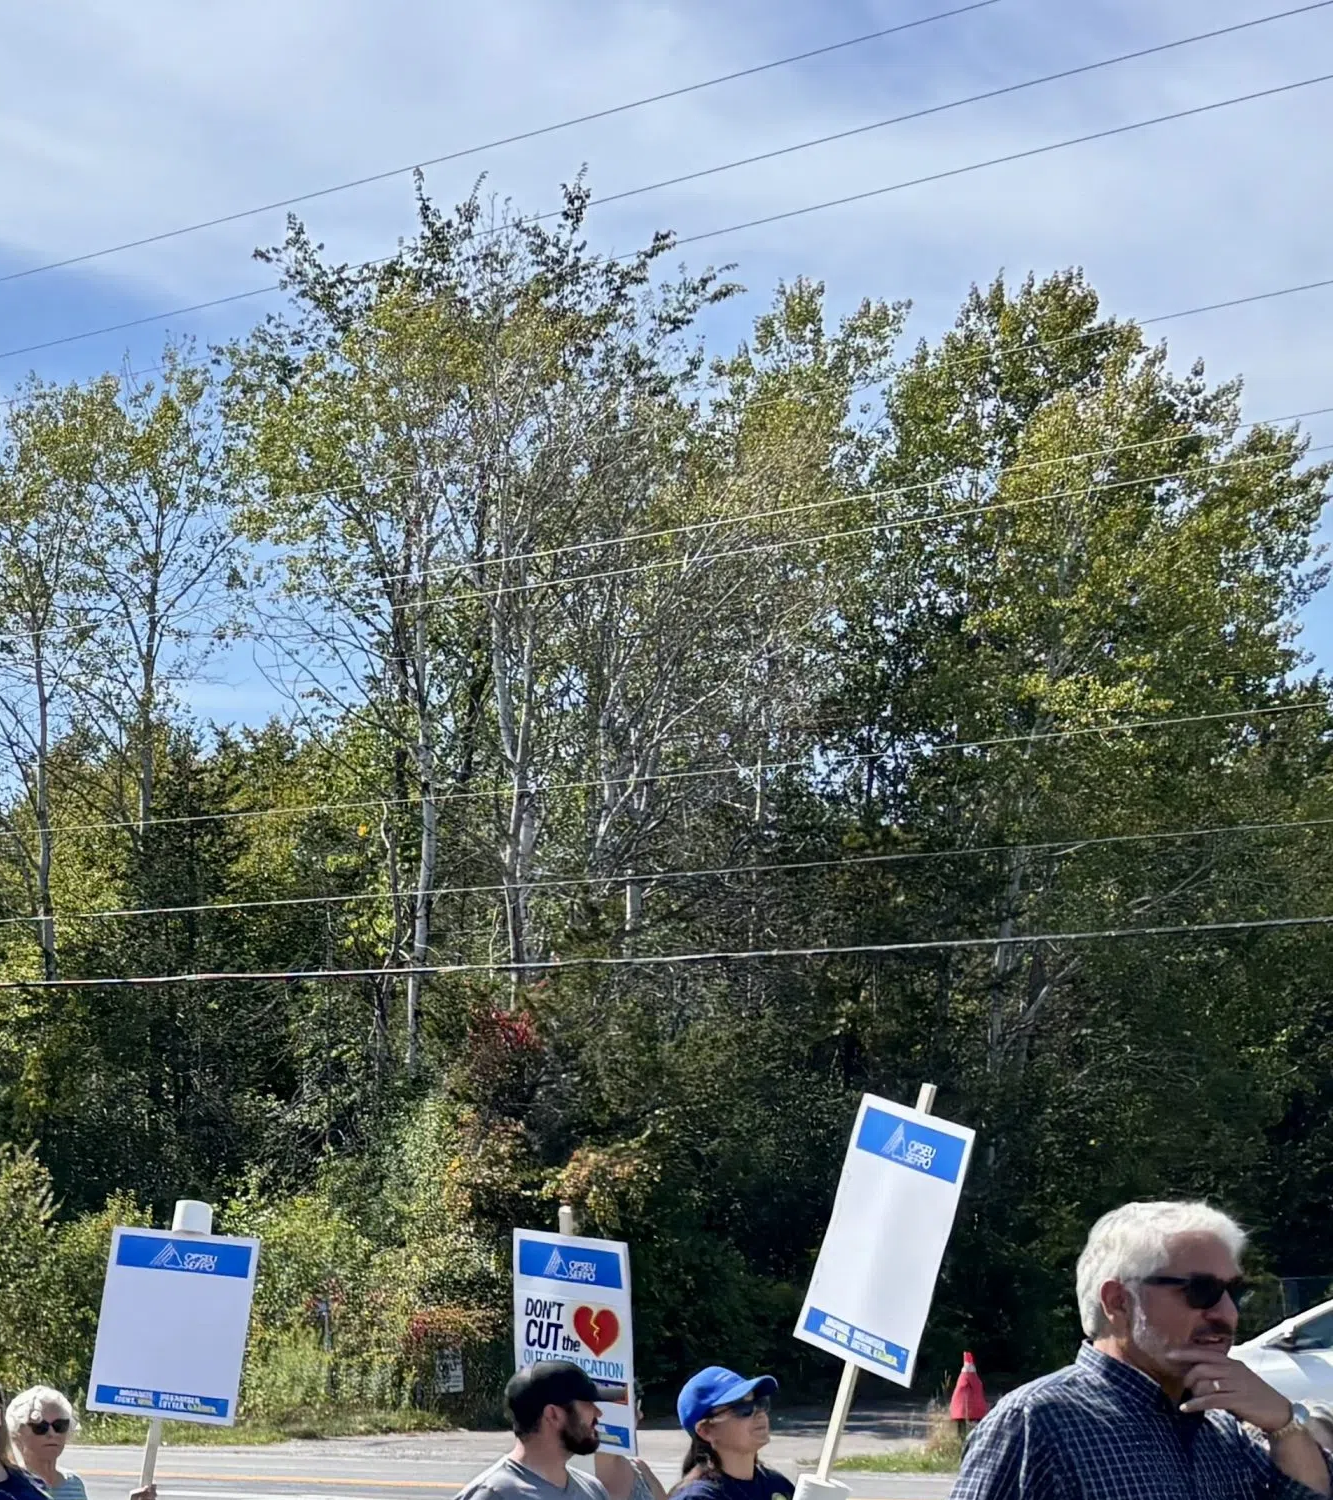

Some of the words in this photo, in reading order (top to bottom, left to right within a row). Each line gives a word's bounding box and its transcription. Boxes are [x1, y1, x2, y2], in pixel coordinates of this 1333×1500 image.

[525, 1297, 565, 1321] DON'T
[525, 1319, 563, 1351] CUT
[562, 1334, 581, 1352] the
